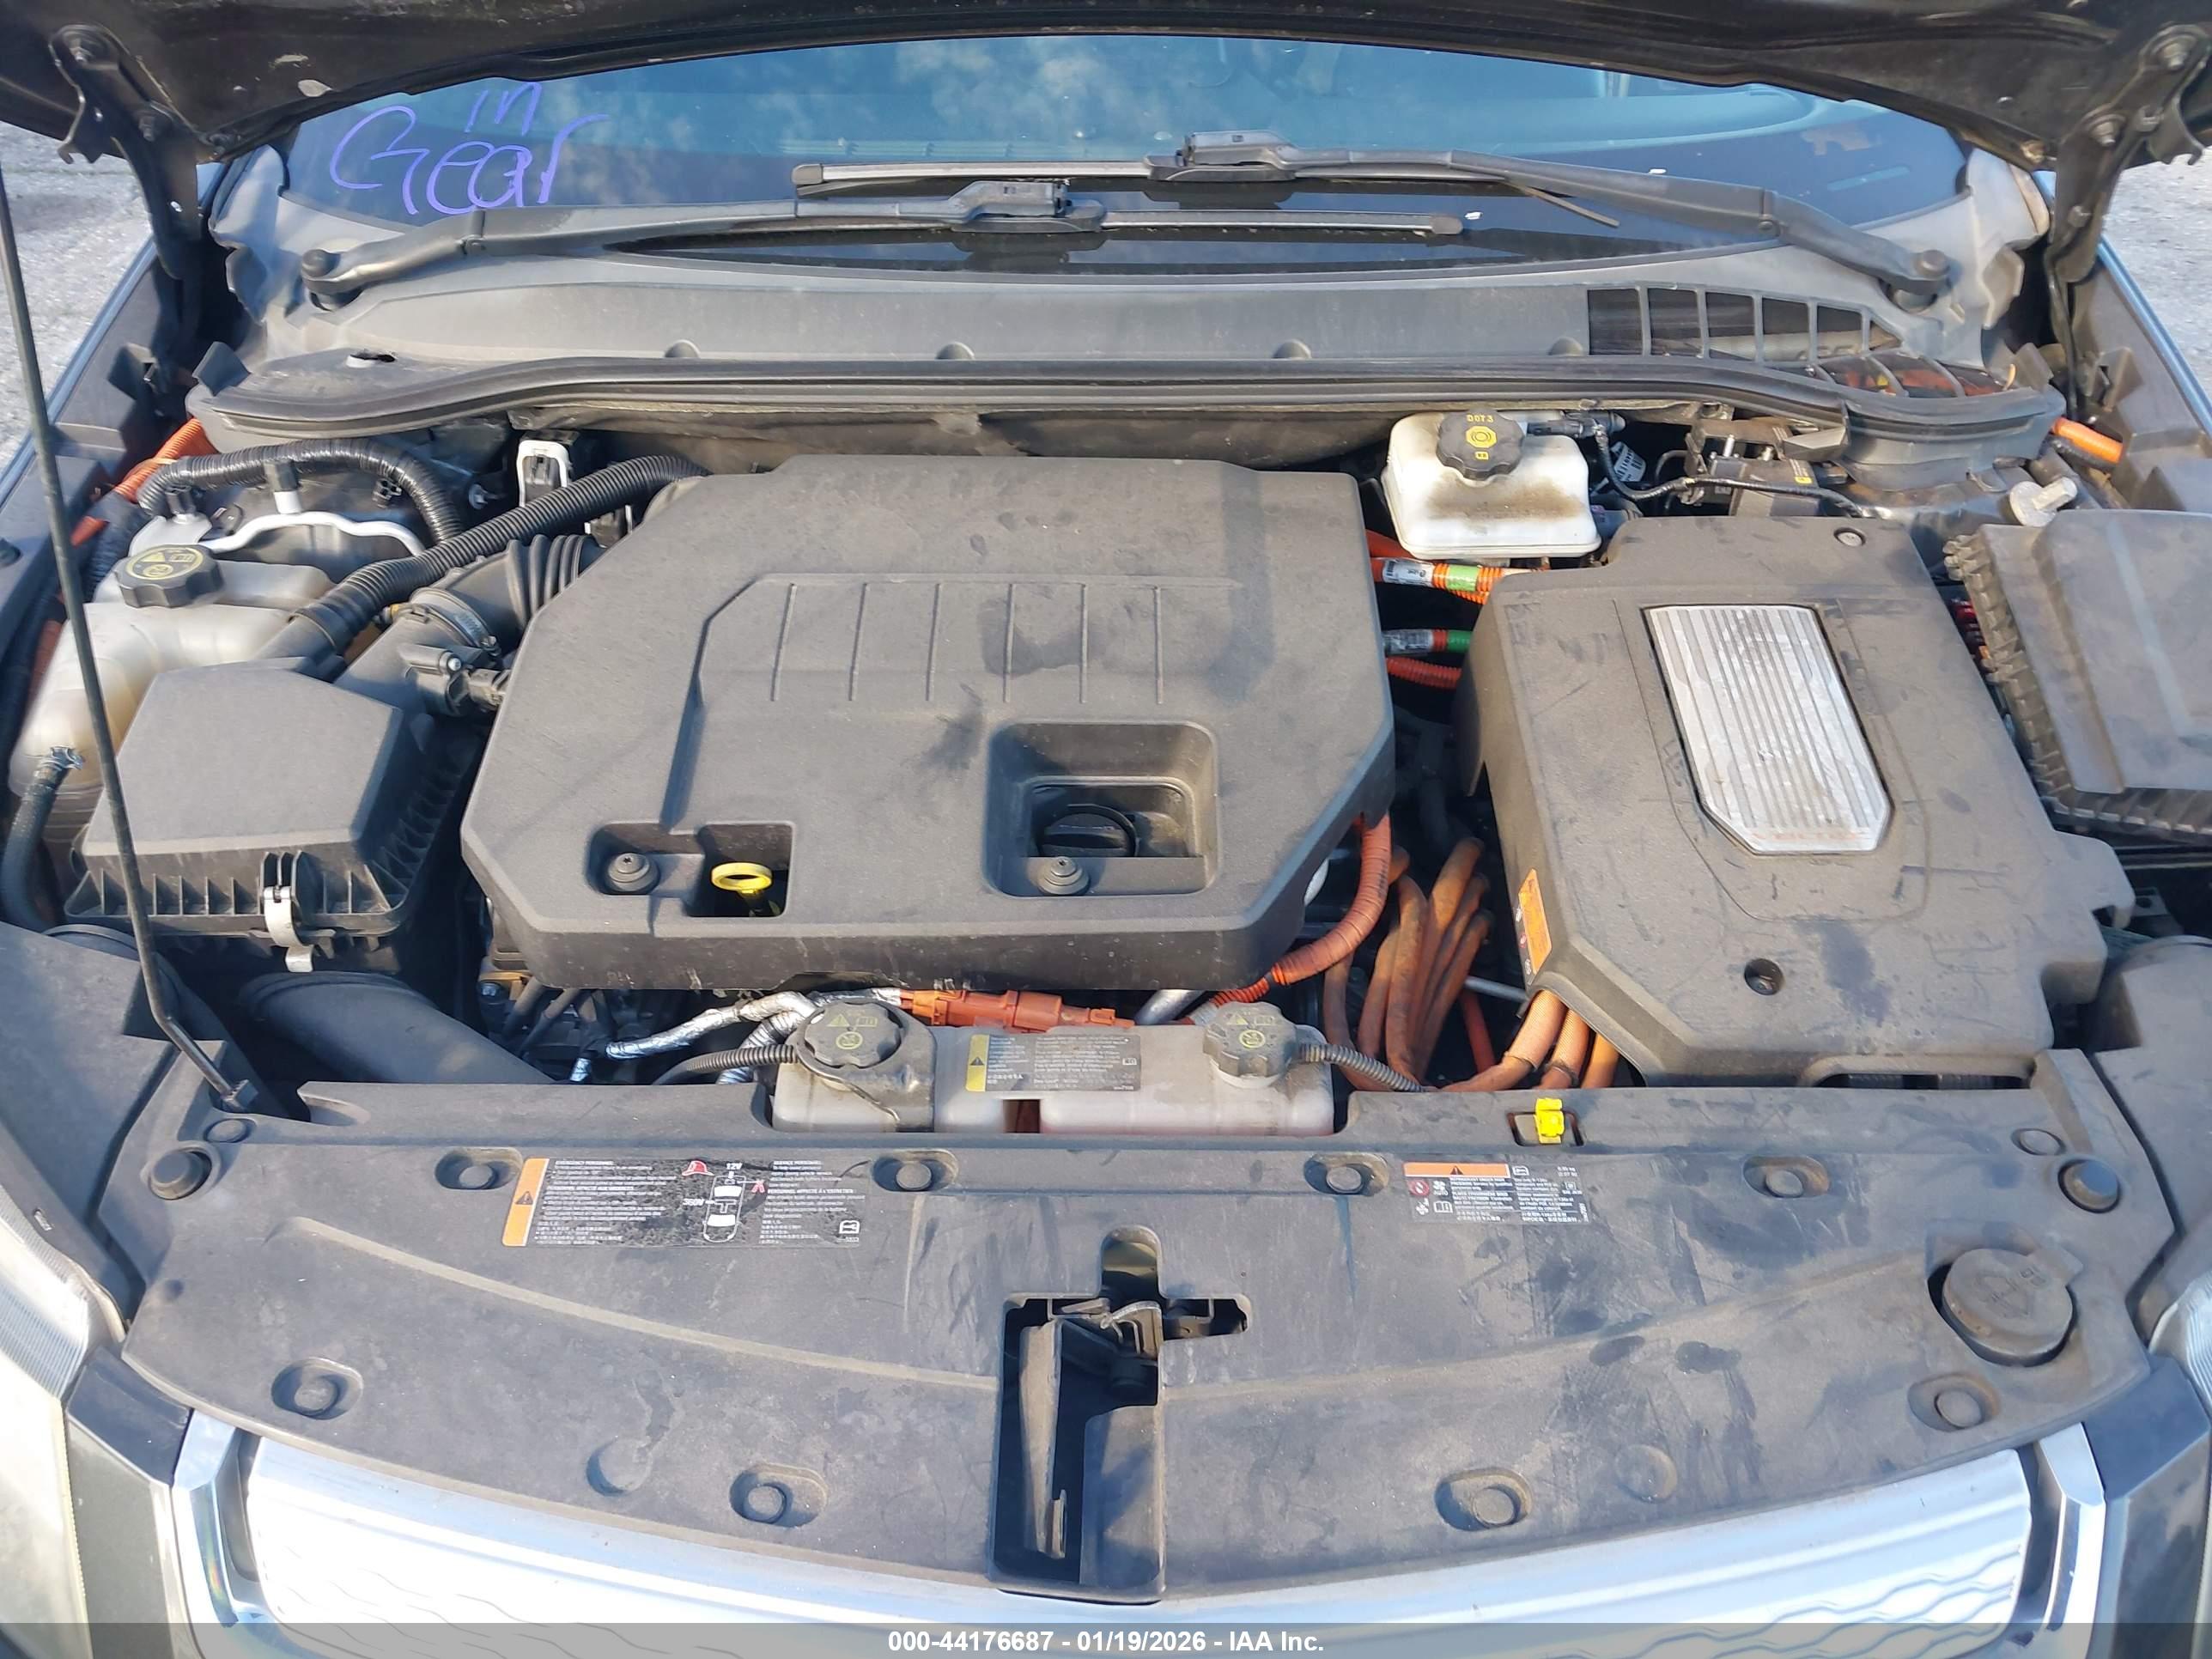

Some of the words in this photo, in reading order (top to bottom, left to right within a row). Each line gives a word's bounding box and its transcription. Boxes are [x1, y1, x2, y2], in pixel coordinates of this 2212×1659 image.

[465, 81, 542, 136] in
[329, 105, 611, 215] Gear
[1466, 414, 1486, 422] DOT
[726, 1162, 743, 1170] 12V
